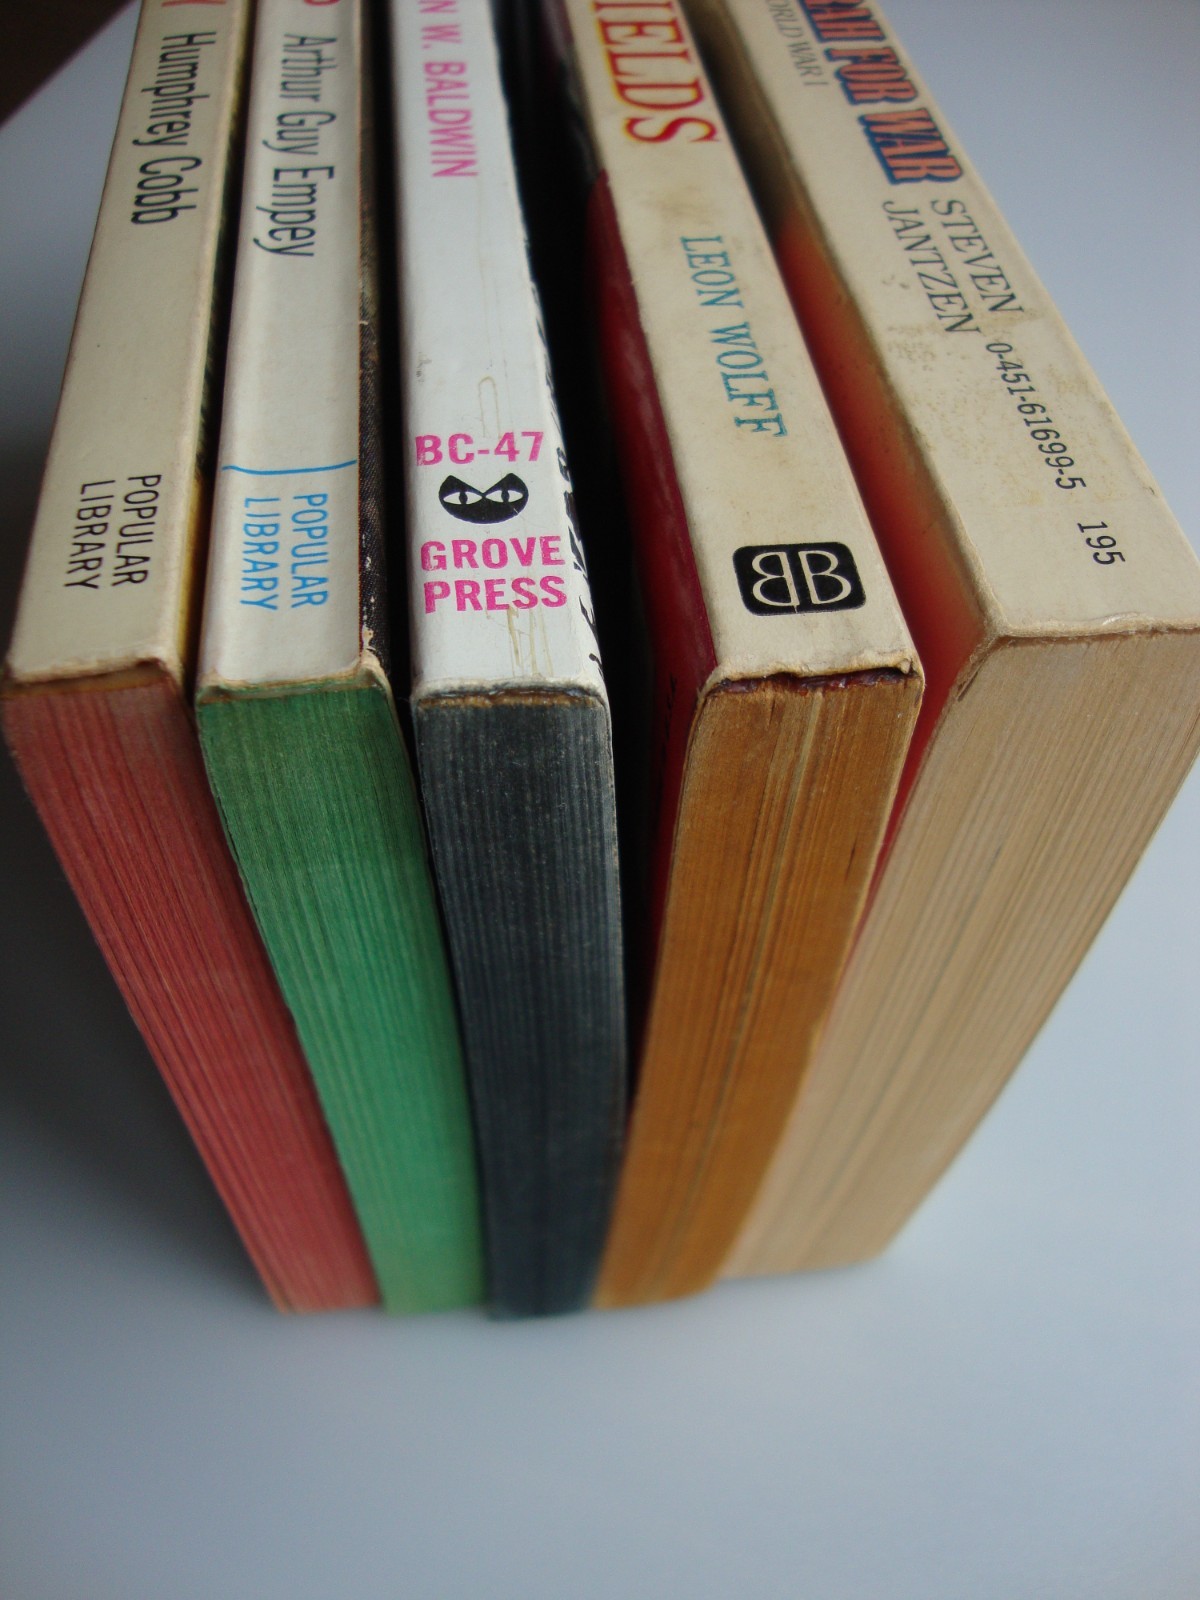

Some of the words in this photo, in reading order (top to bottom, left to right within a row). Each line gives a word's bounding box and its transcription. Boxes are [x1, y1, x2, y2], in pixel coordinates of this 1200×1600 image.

[279, 33, 337, 102] Arthur
[421, 23, 464, 50] W.
[787, 41, 822, 77] WAR
[132, 31, 217, 147] Humphrey
[824, 46, 918, 106] FOR
[262, 110, 337, 155] Guy
[423, 62, 478, 177] BALDWIN
[858, 107, 963, 185] WAR
[131, 156, 202, 225] Cobb
[253, 166, 335, 257] Empey
[681, 235, 744, 309] LEON
[882, 200, 981, 333] JANTZEN
[931, 199, 1024, 315] STEVEN
[709, 321, 787, 437] WOLFF
[985, 342, 1086, 490] 0-451-61699-5
[415, 431, 544, 467] BC-47
[64, 479, 116, 589] LIBRARY
[111, 474, 161, 586] POPULAR
[239, 497, 280, 610] LIBRARY
[290, 493, 329, 608] POPULAR
[420, 535, 565, 571] GROVE
[1077, 520, 1125, 565] 195
[423, 575, 568, 614] PRESS
